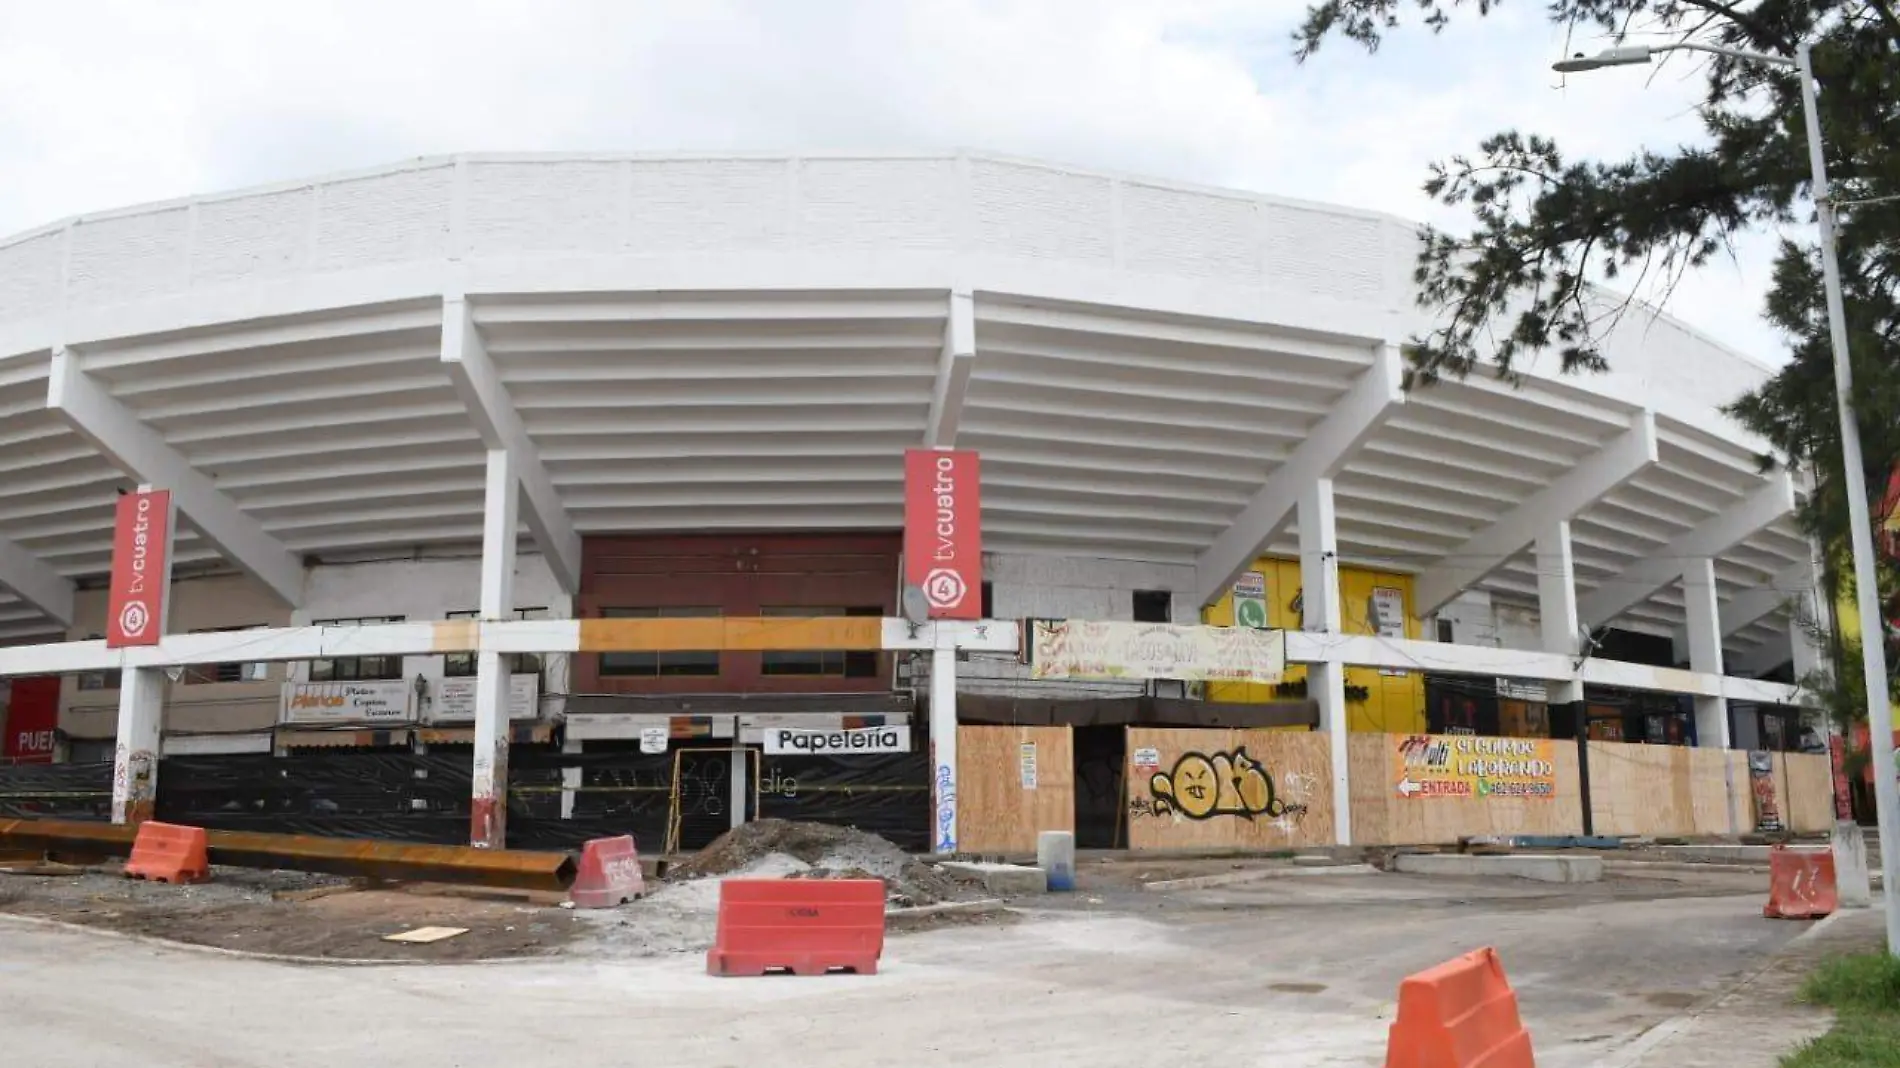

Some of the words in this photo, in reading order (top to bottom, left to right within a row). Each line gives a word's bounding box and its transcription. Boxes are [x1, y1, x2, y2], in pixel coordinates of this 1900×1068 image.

[128, 498, 151, 594] tvcuatro
[932, 456, 955, 562] tvcuatro
[1421, 779, 1472, 795] ENTRADA
